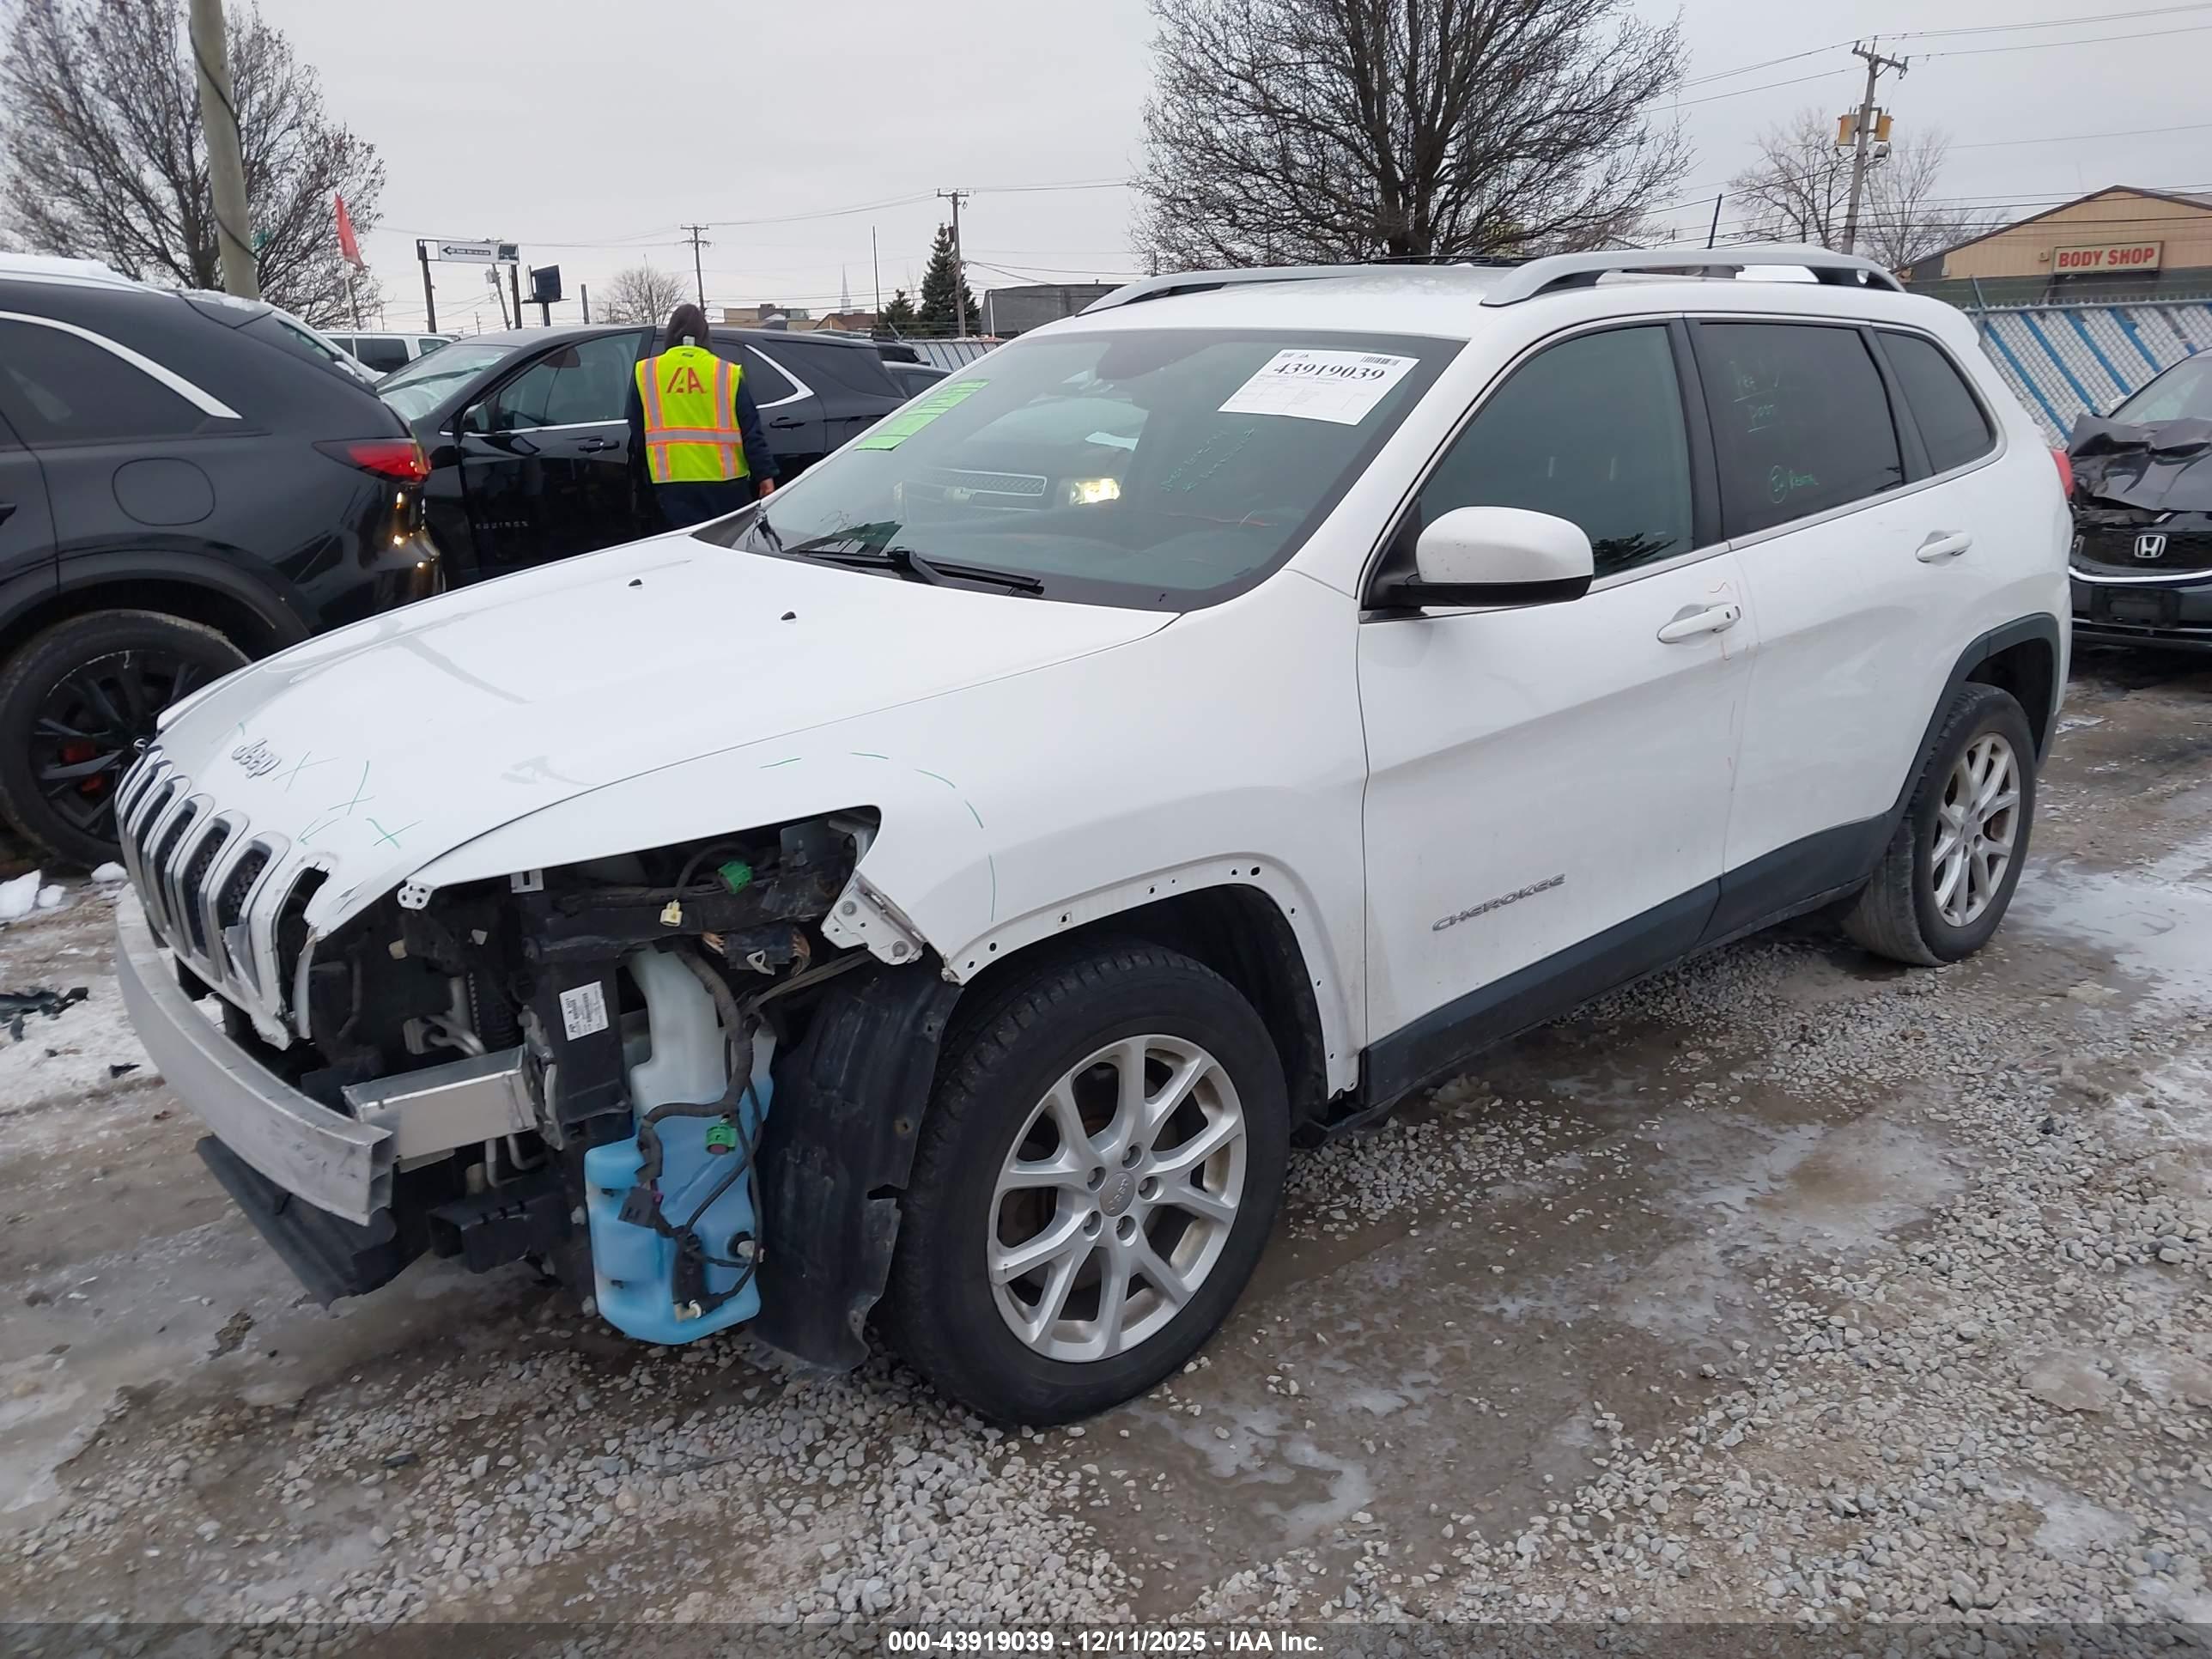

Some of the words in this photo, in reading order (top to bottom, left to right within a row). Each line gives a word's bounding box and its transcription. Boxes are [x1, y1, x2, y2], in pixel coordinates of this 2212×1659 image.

[2058, 250, 2103, 268] BODY
[2106, 246, 2155, 266] SHOP
[1273, 362, 1386, 381] 43919039
[231, 737, 282, 779] Jeep
[1431, 872, 1565, 932] CHEROKEE
